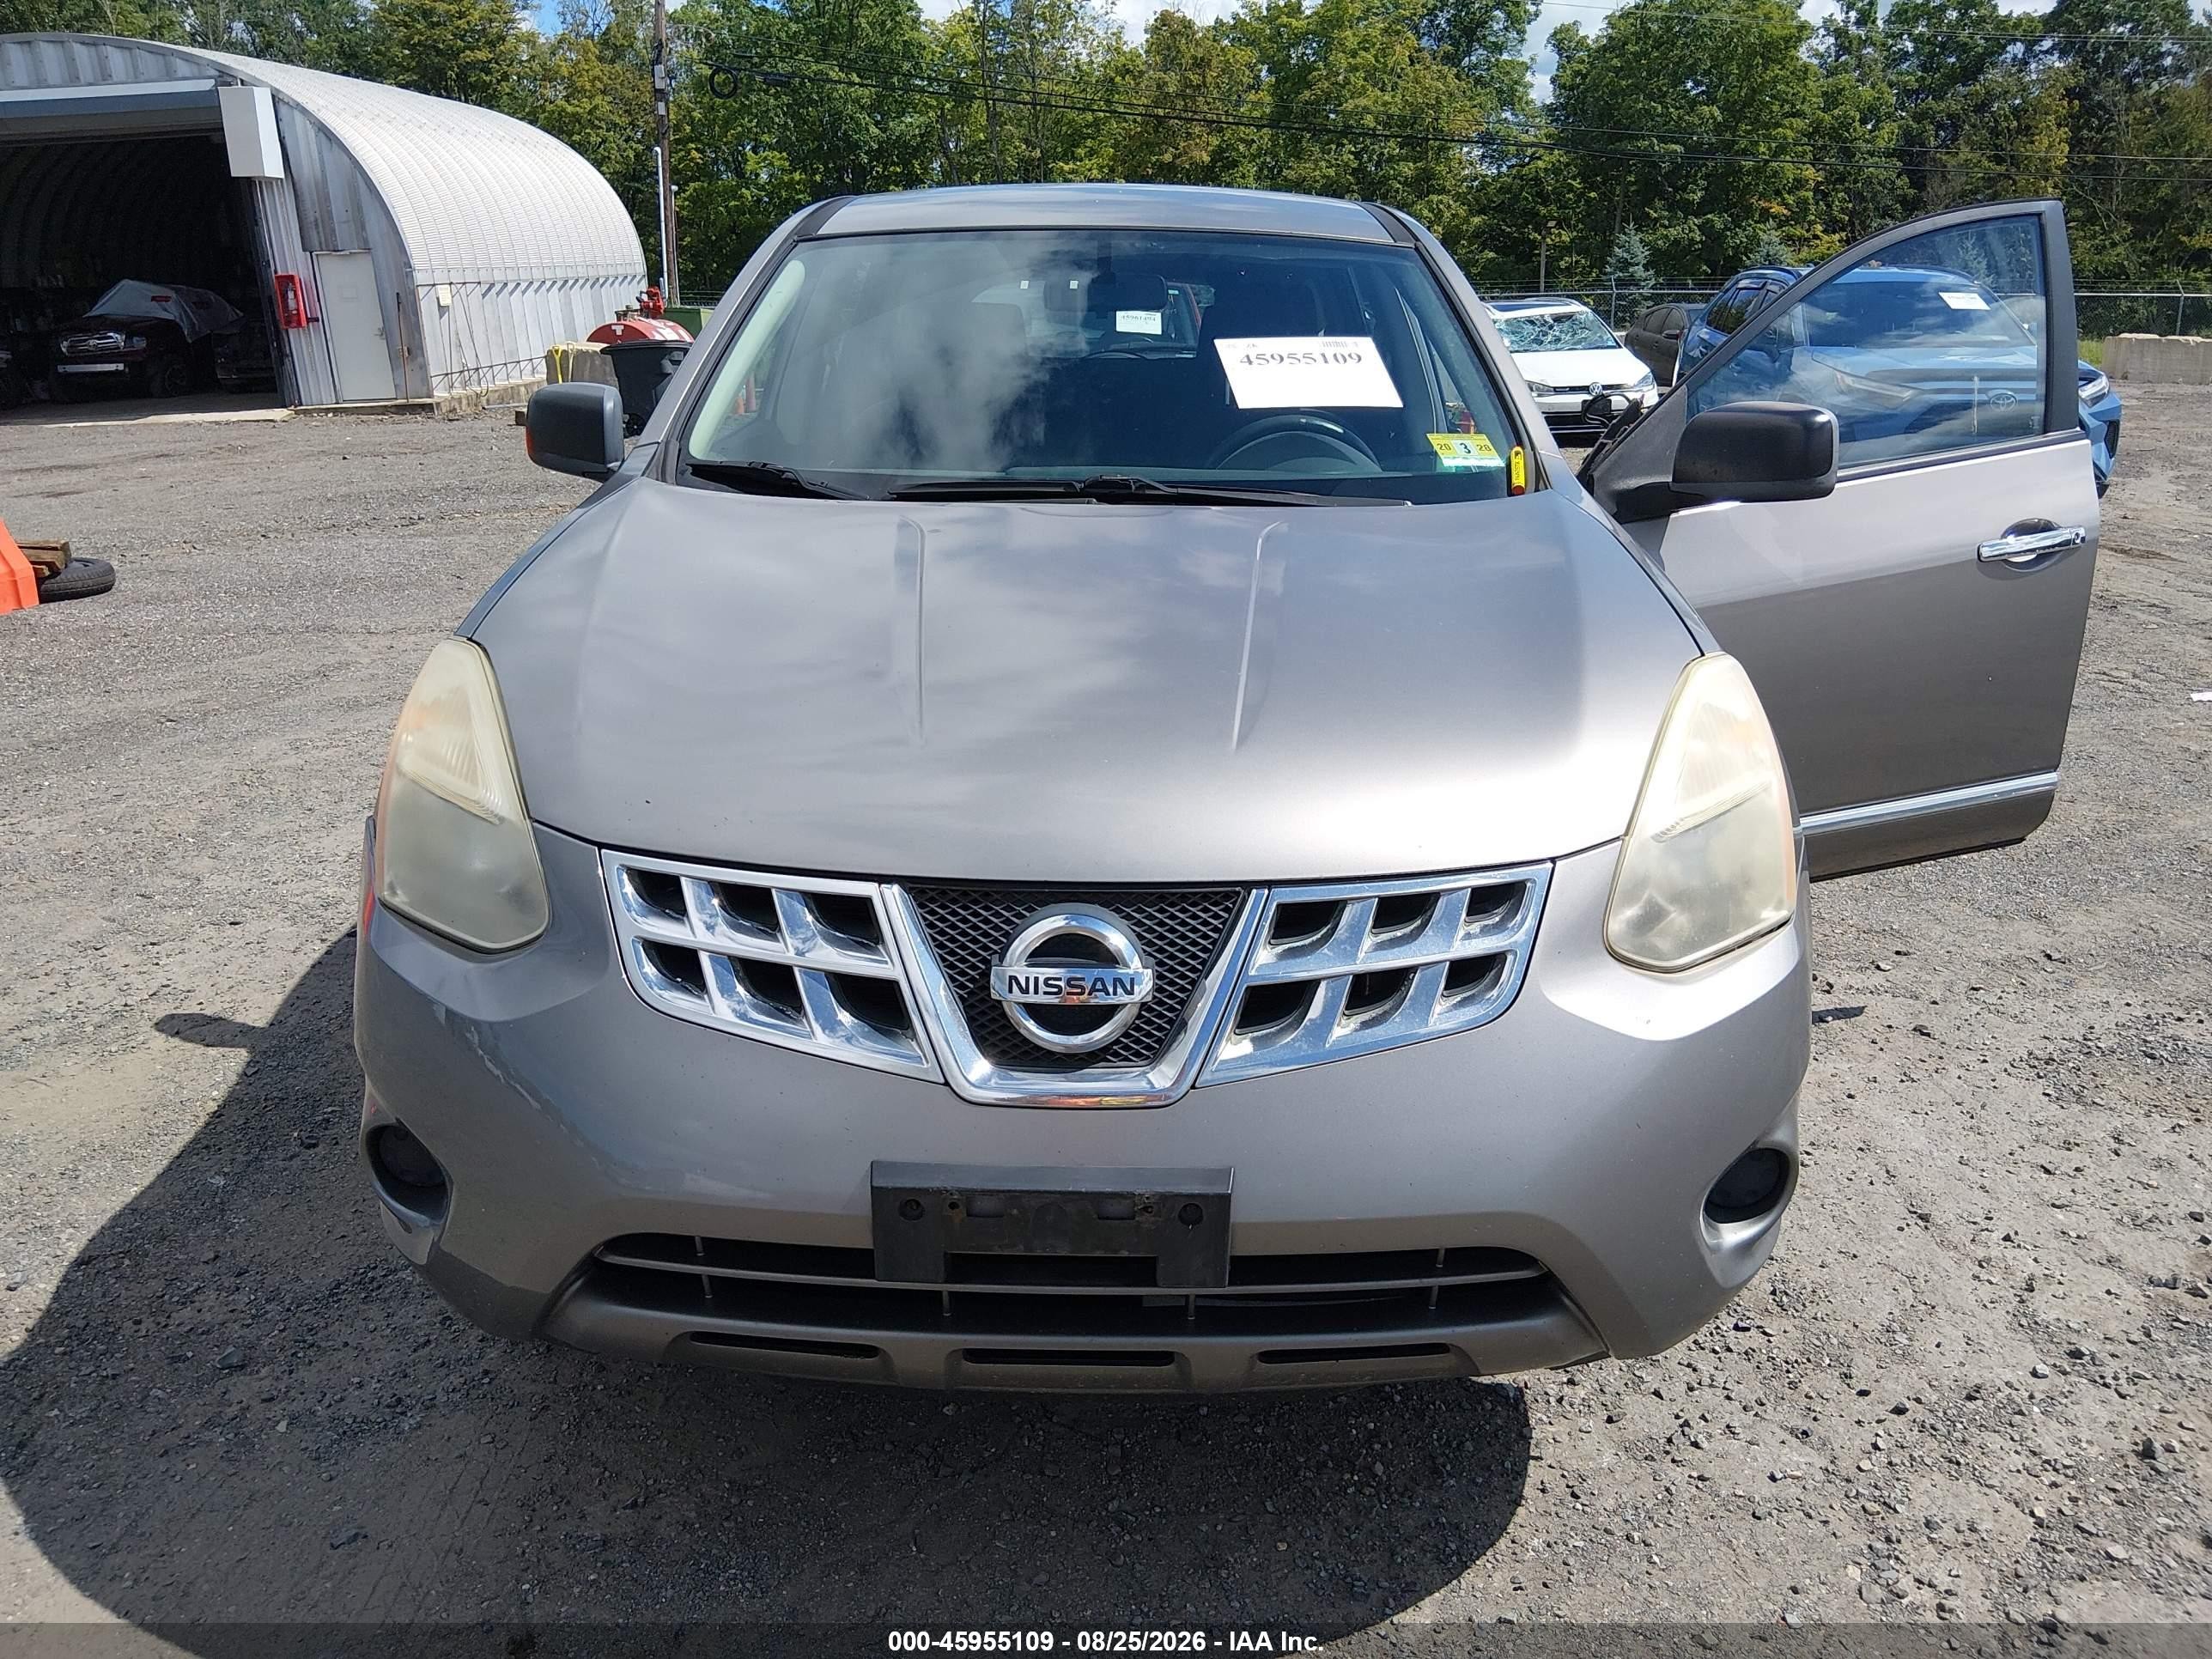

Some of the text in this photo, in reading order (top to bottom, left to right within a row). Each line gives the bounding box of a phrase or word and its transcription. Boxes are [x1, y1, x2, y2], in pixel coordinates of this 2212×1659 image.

[1239, 352, 1363, 366] 45955109
[1459, 442, 1472, 454] 3
[1008, 975, 1135, 996] NISSAN
